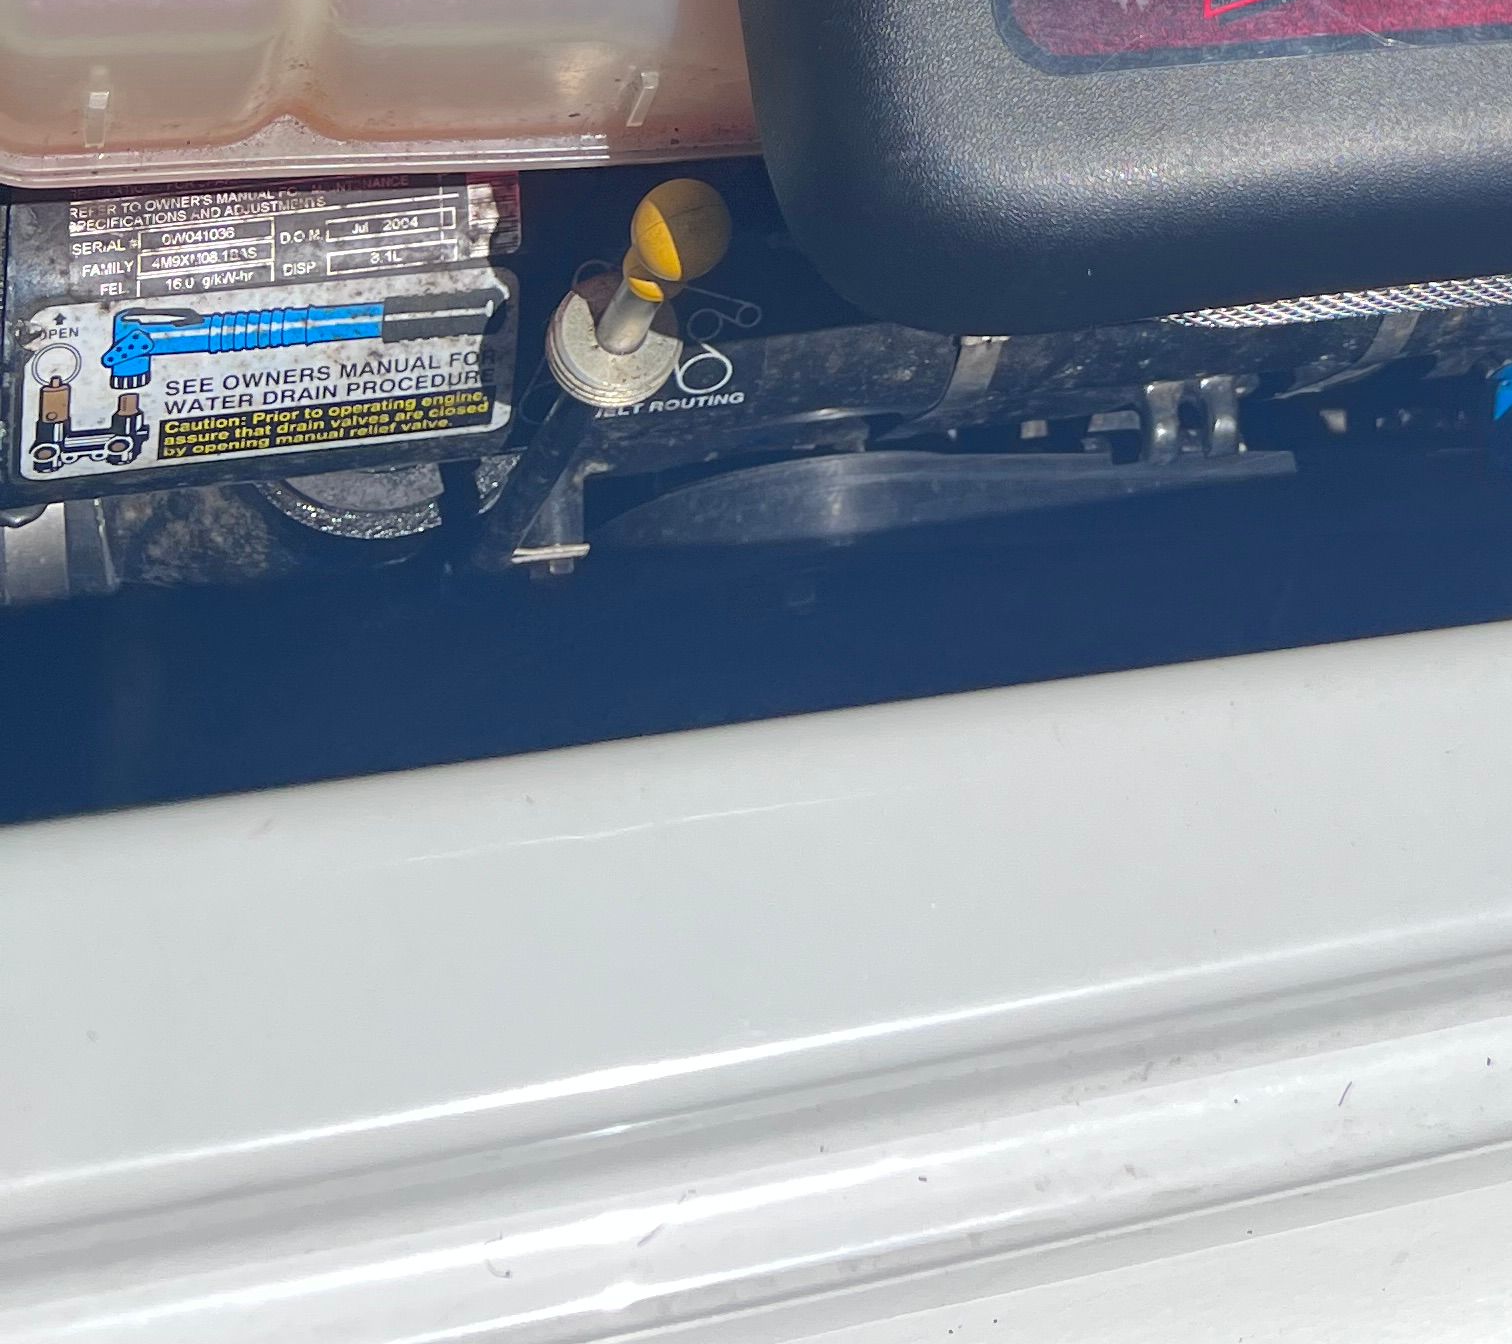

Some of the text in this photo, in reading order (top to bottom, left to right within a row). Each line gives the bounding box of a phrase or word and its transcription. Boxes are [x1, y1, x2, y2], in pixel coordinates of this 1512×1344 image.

[145, 194, 212, 210] OWNER'S
[216, 190, 275, 204] MANUAL
[191, 208, 221, 220] AND
[72, 240, 126, 256] SERIAL
[81, 261, 134, 278] FAMILY
[165, 350, 495, 396] SEE OWNERS MANUAL FOR
[165, 368, 495, 415] WATER DRAIN PROCEDURE
[649, 392, 745, 412] ROUTING
[164, 401, 490, 445] assure that drain valves are closed
[165, 398, 416, 434] Caution: Prior to operating
[163, 418, 453, 458] by opening manual relief valve.
